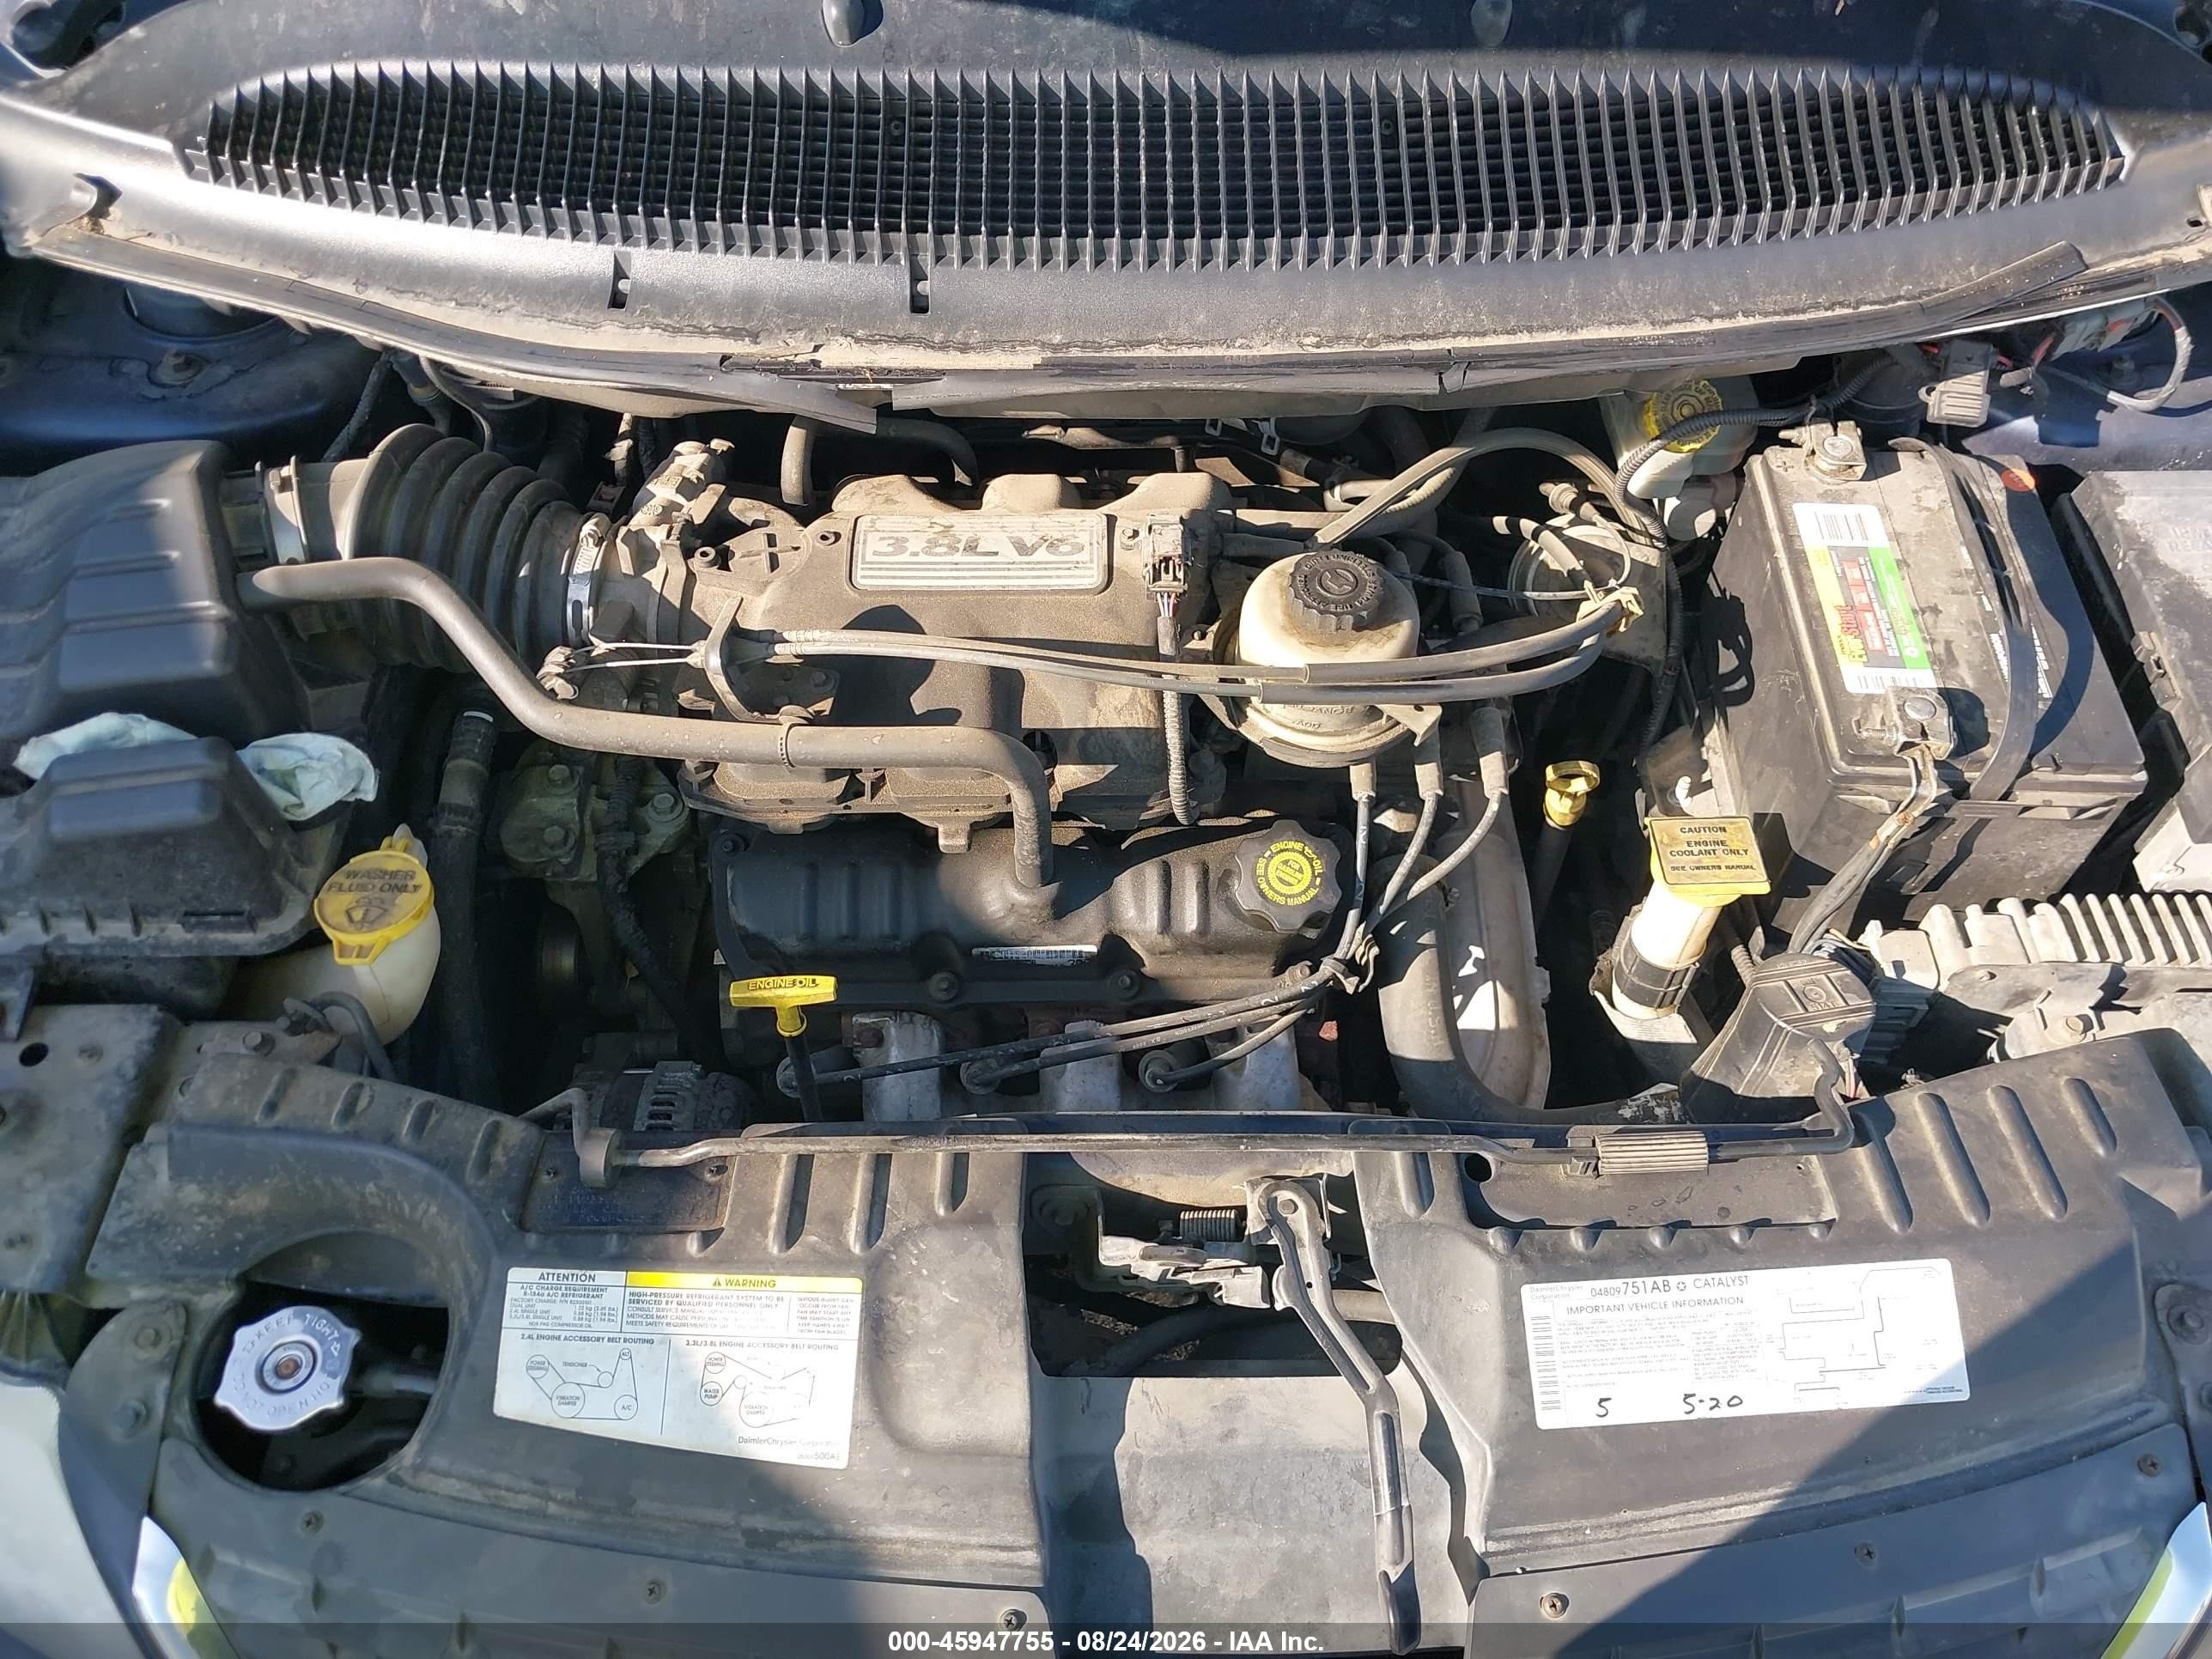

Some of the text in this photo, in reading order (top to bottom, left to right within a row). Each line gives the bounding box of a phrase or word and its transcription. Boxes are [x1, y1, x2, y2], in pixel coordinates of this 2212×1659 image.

[872, 535, 1085, 557] 3.8L V6
[1271, 841, 1323, 876] ENGINE OIL
[1669, 848, 1717, 857] COOLANT
[345, 869, 416, 881] WASHER
[327, 882, 422, 893] FLUID ONLY
[1255, 857, 1319, 906] SEE OWNERS MANUAL
[749, 977, 818, 990] ENGINE OIL
[538, 1272, 597, 1283] ATTENTION
[725, 1278, 776, 1288] WARNING
[1529, 1285, 1583, 1293] DaimlerChrysler
[1590, 1275, 1749, 1297] 04809751AB CATALYST
[629, 1291, 684, 1299] HIGH-PRESSURE
[1566, 1296, 1744, 1316] IMPORTANT VEHICLE INFORMATION
[1595, 1397, 1612, 1418] 5
[738, 1436, 796, 1447] DaimlerChrysler
